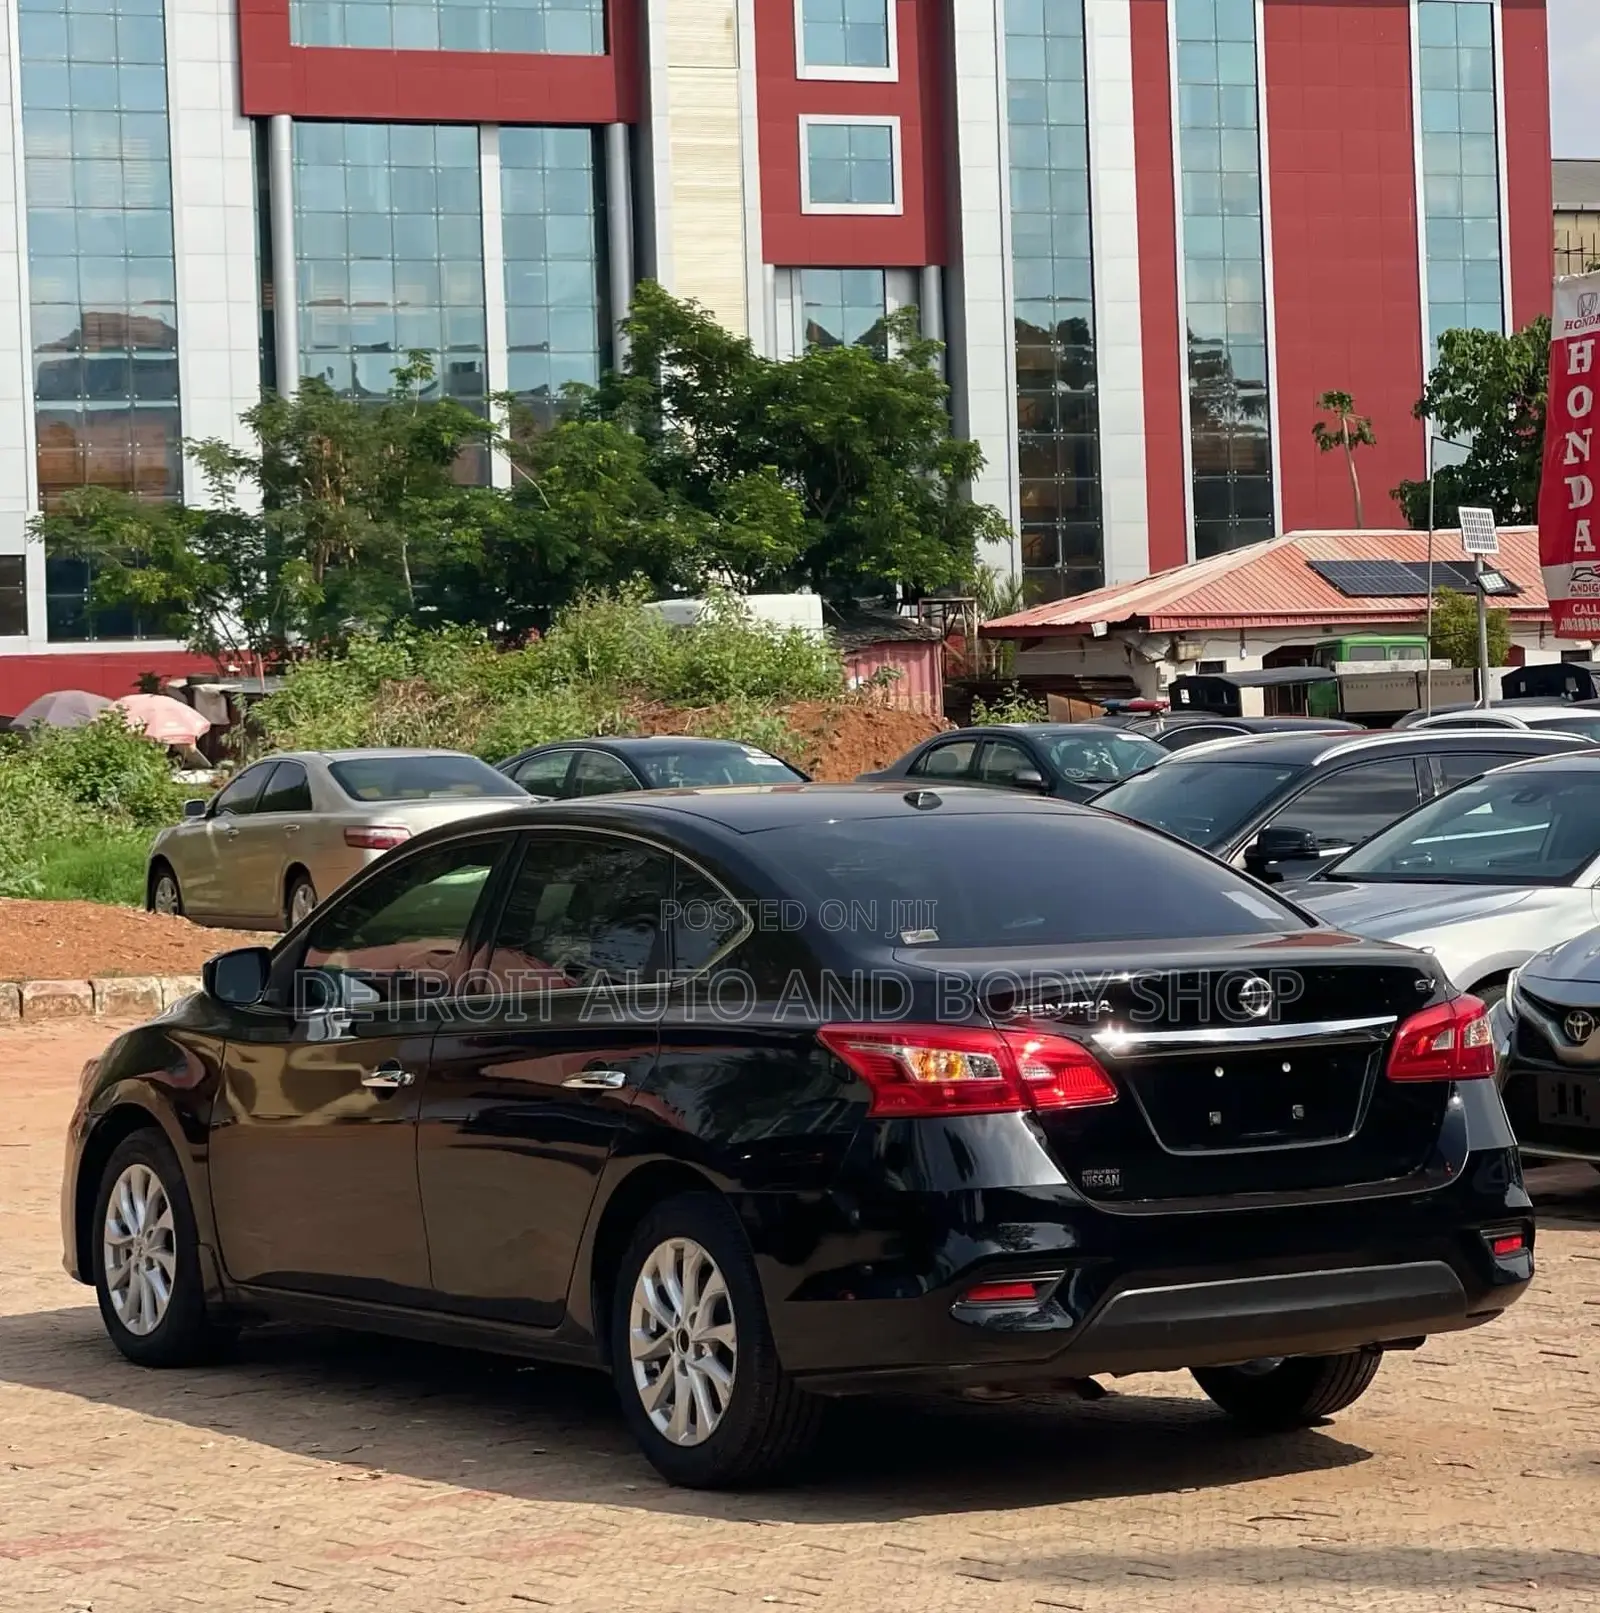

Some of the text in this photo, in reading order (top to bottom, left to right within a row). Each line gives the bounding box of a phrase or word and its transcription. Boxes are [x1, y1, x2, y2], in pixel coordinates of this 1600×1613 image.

[1563, 339, 1596, 552] HONDA
[1573, 603, 1600, 615] CALL
[1012, 1000, 1115, 1015] SENTRA
[1081, 1174, 1120, 1187] NISSAN
